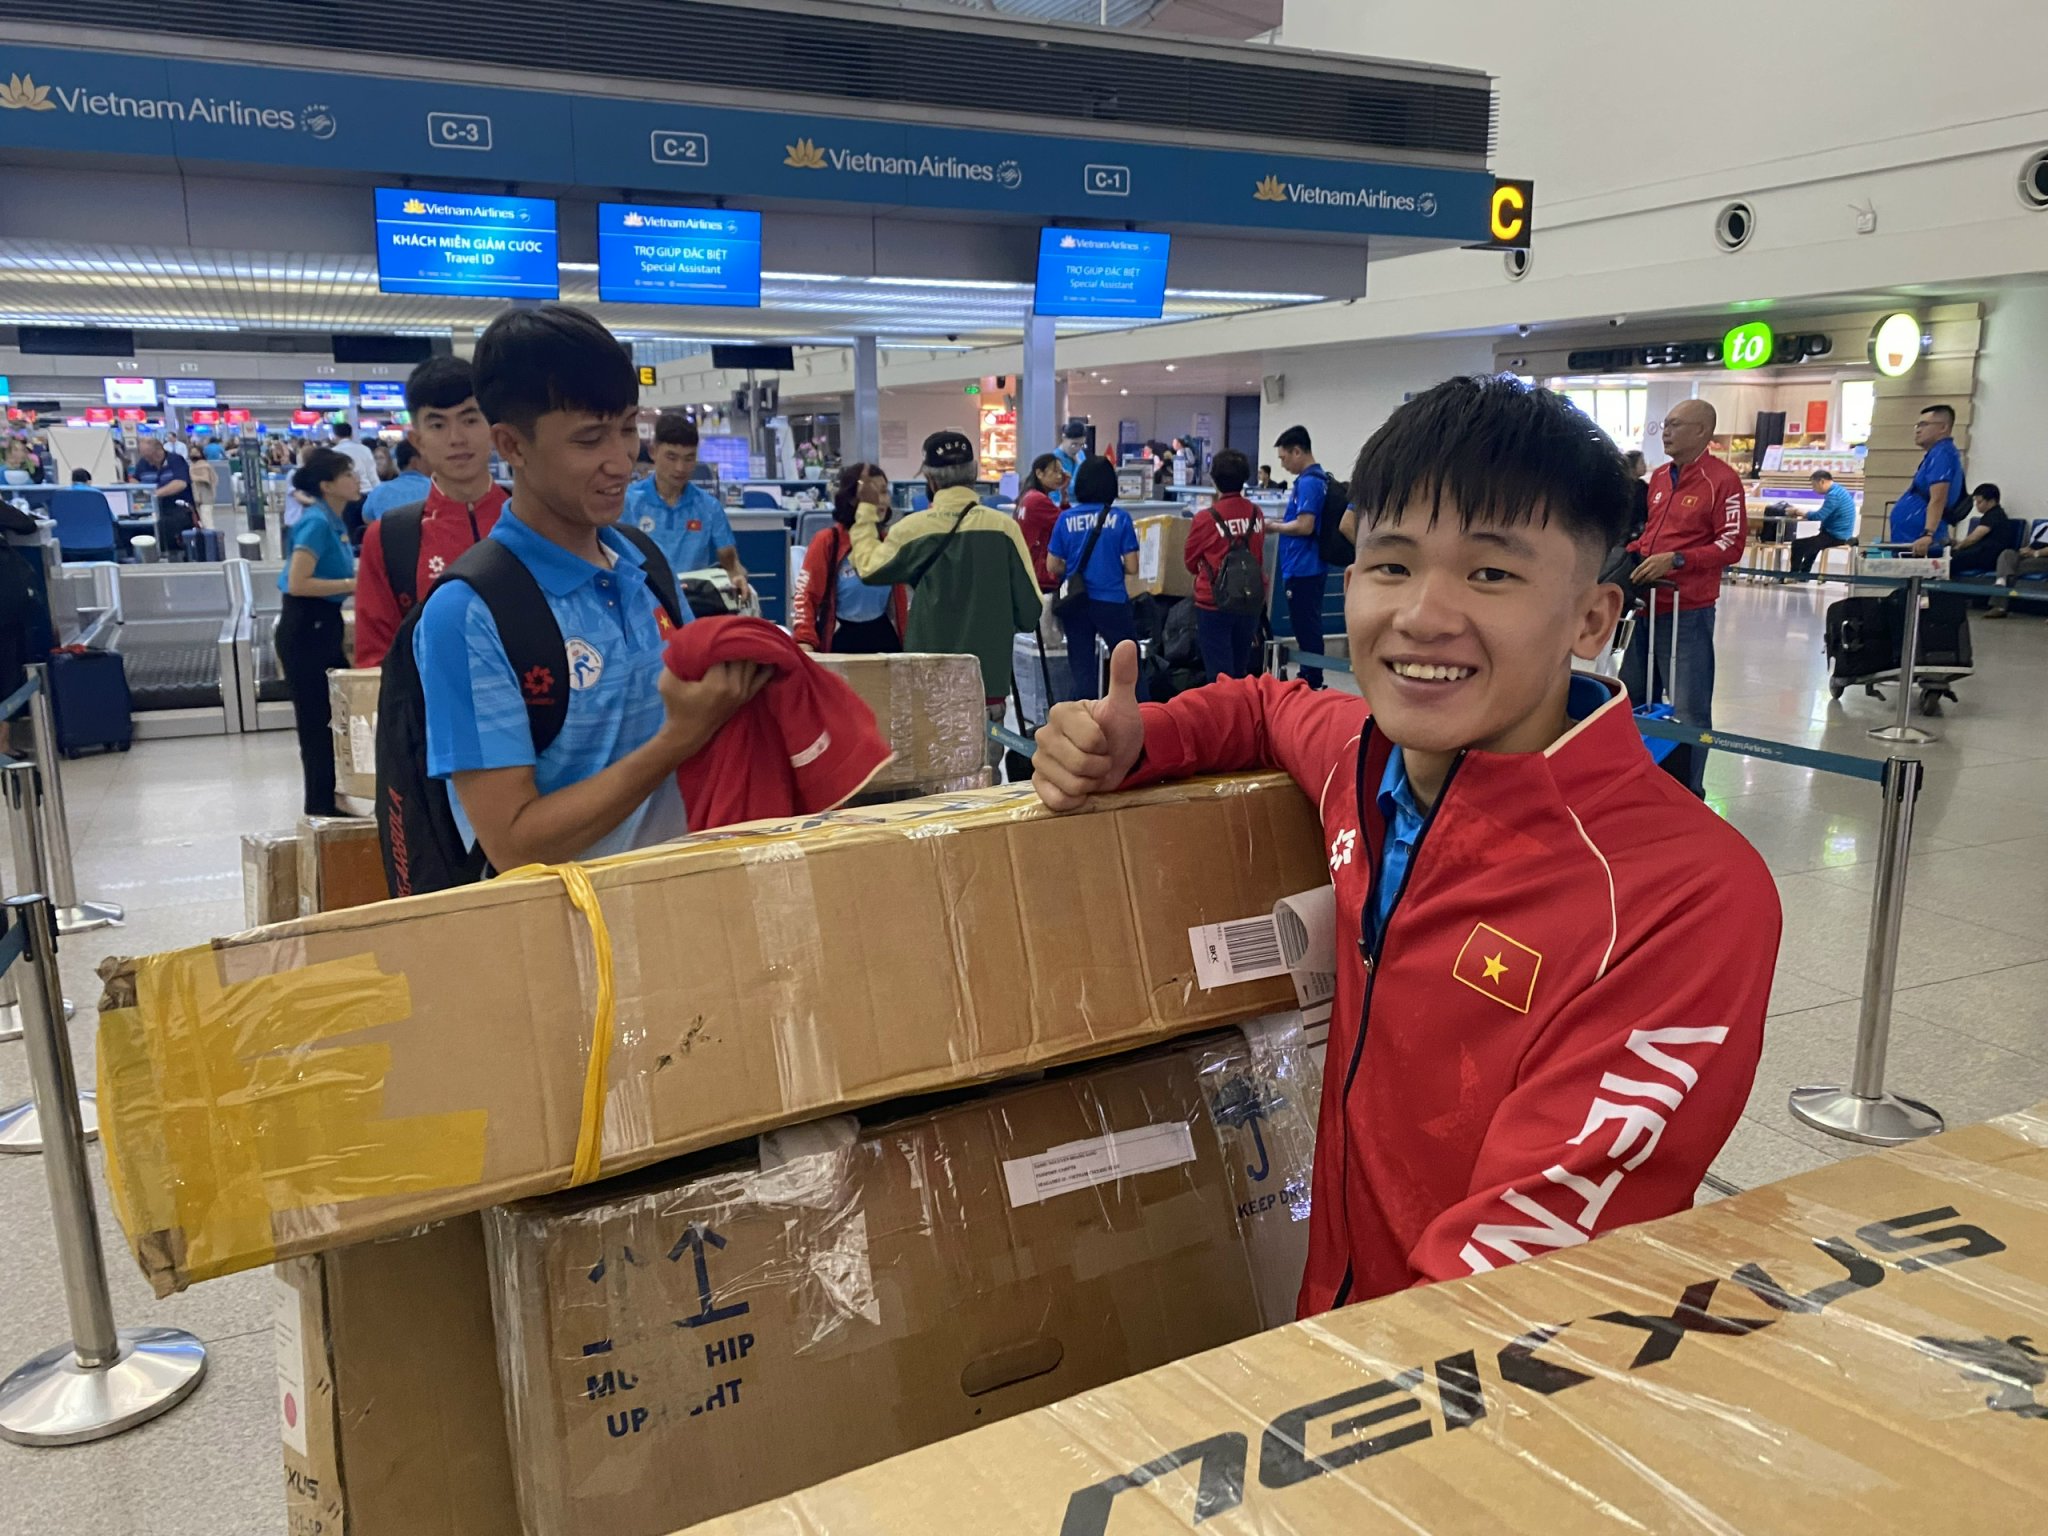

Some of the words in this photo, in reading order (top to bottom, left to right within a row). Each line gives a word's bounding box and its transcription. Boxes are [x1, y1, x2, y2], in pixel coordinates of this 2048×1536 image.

[441, 120, 479, 142] C-3
[663, 138, 697, 158] C-2
[1095, 171, 1121, 189] C-1
[1490, 186, 1524, 241] C
[392, 233, 437, 247] KHÁCH
[444, 251, 479, 264] Travel
[482, 253, 495, 265] ID
[641, 260, 676, 273] Special
[678, 263, 721, 275] Assistant
[1731, 331, 1764, 364] to
[1065, 511, 1118, 533] VIETNM
[1208, 944, 1219, 964] BKK
[1459, 1025, 1729, 1276] VIETN
[1237, 1193, 1276, 1219] KEEP
[705, 1333, 755, 1368] HIP
